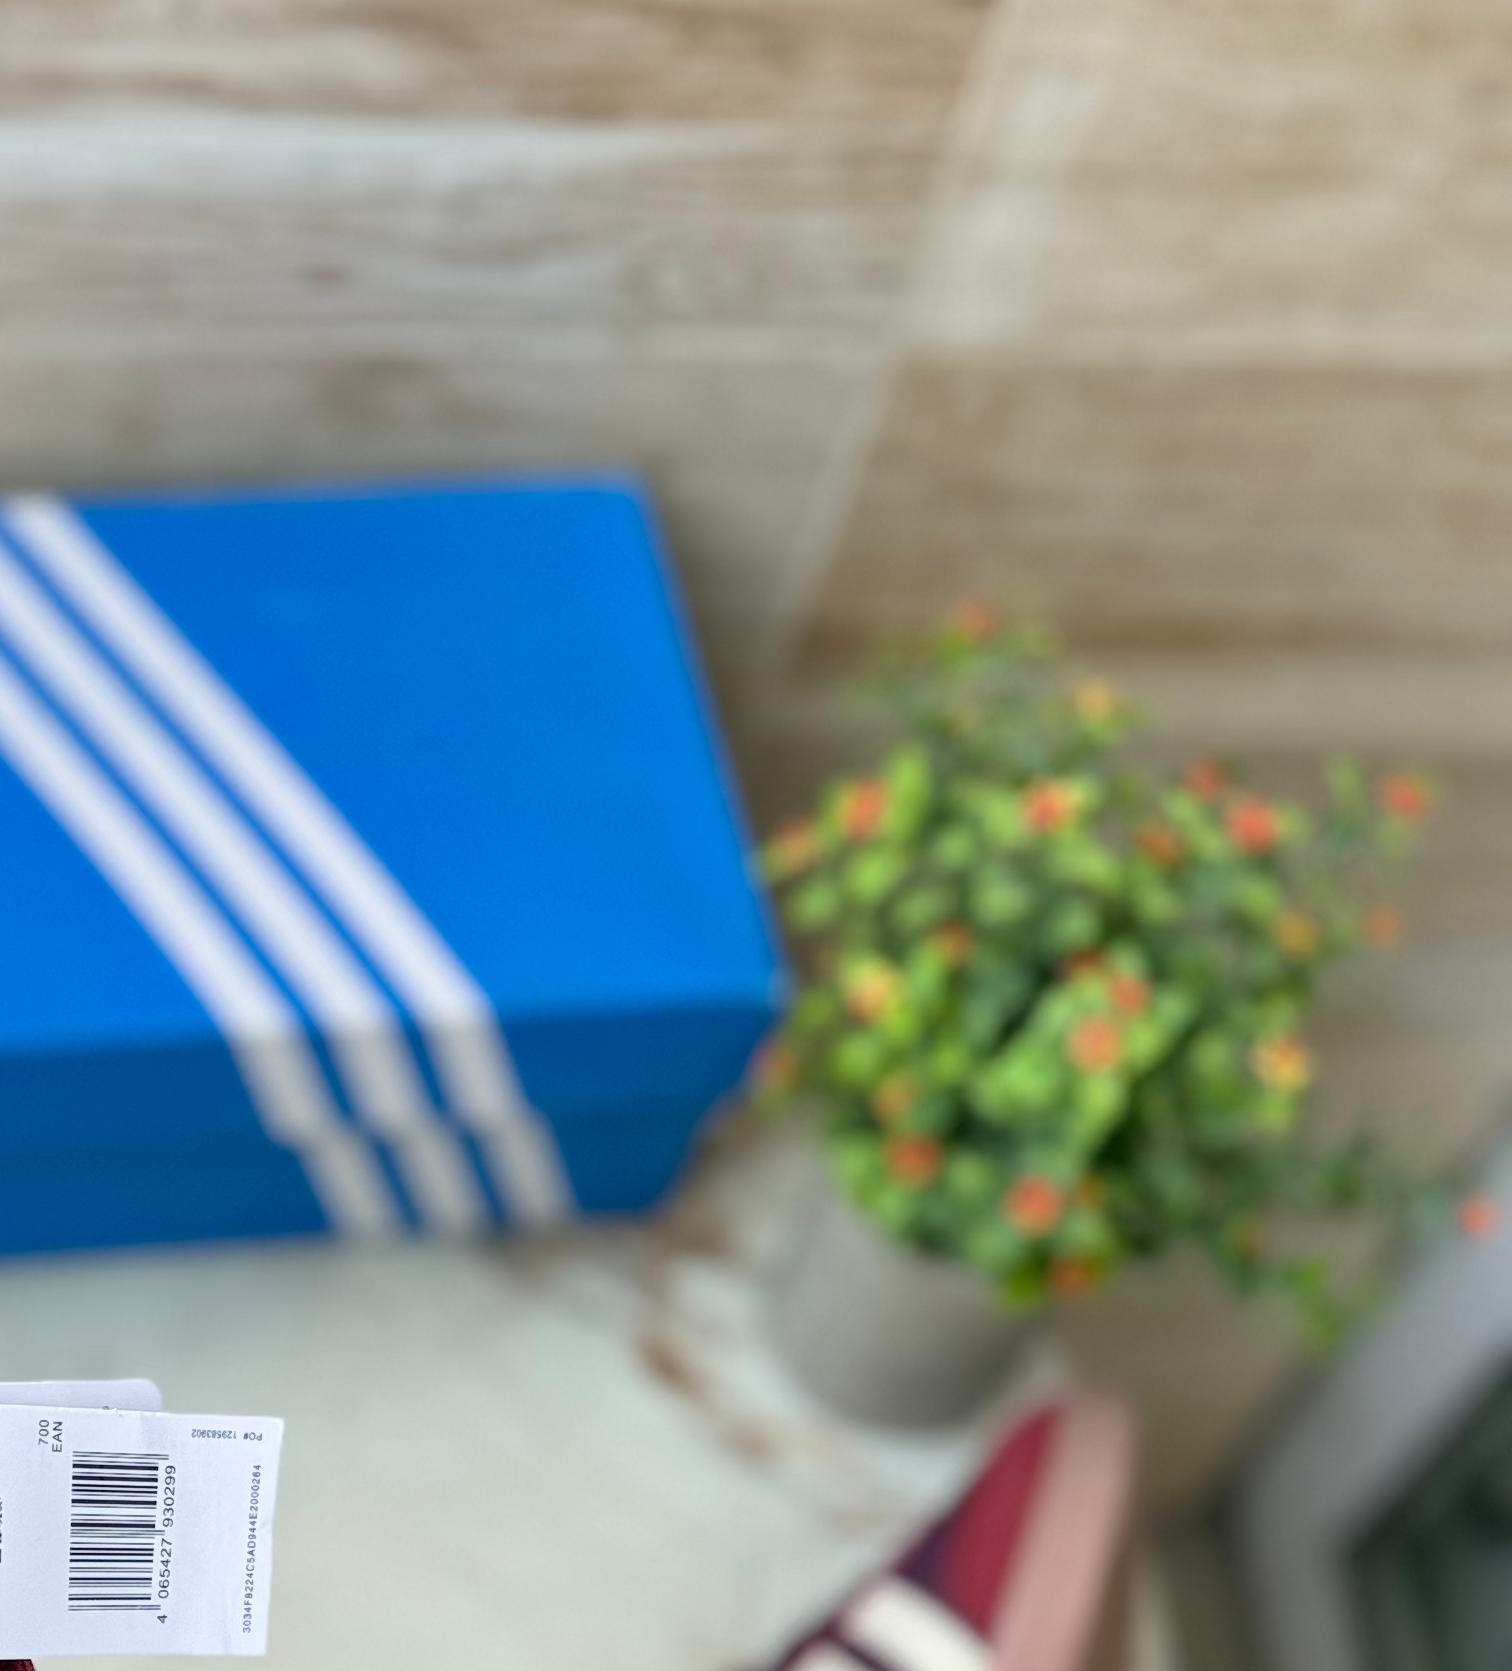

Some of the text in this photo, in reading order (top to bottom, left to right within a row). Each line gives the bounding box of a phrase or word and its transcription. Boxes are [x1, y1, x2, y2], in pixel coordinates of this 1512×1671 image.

[38, 1419, 50, 1446] 700
[52, 1420, 64, 1453] EAN
[243, 1431, 263, 1441] PO#
[157, 1465, 176, 1624] 4 065427 930299
